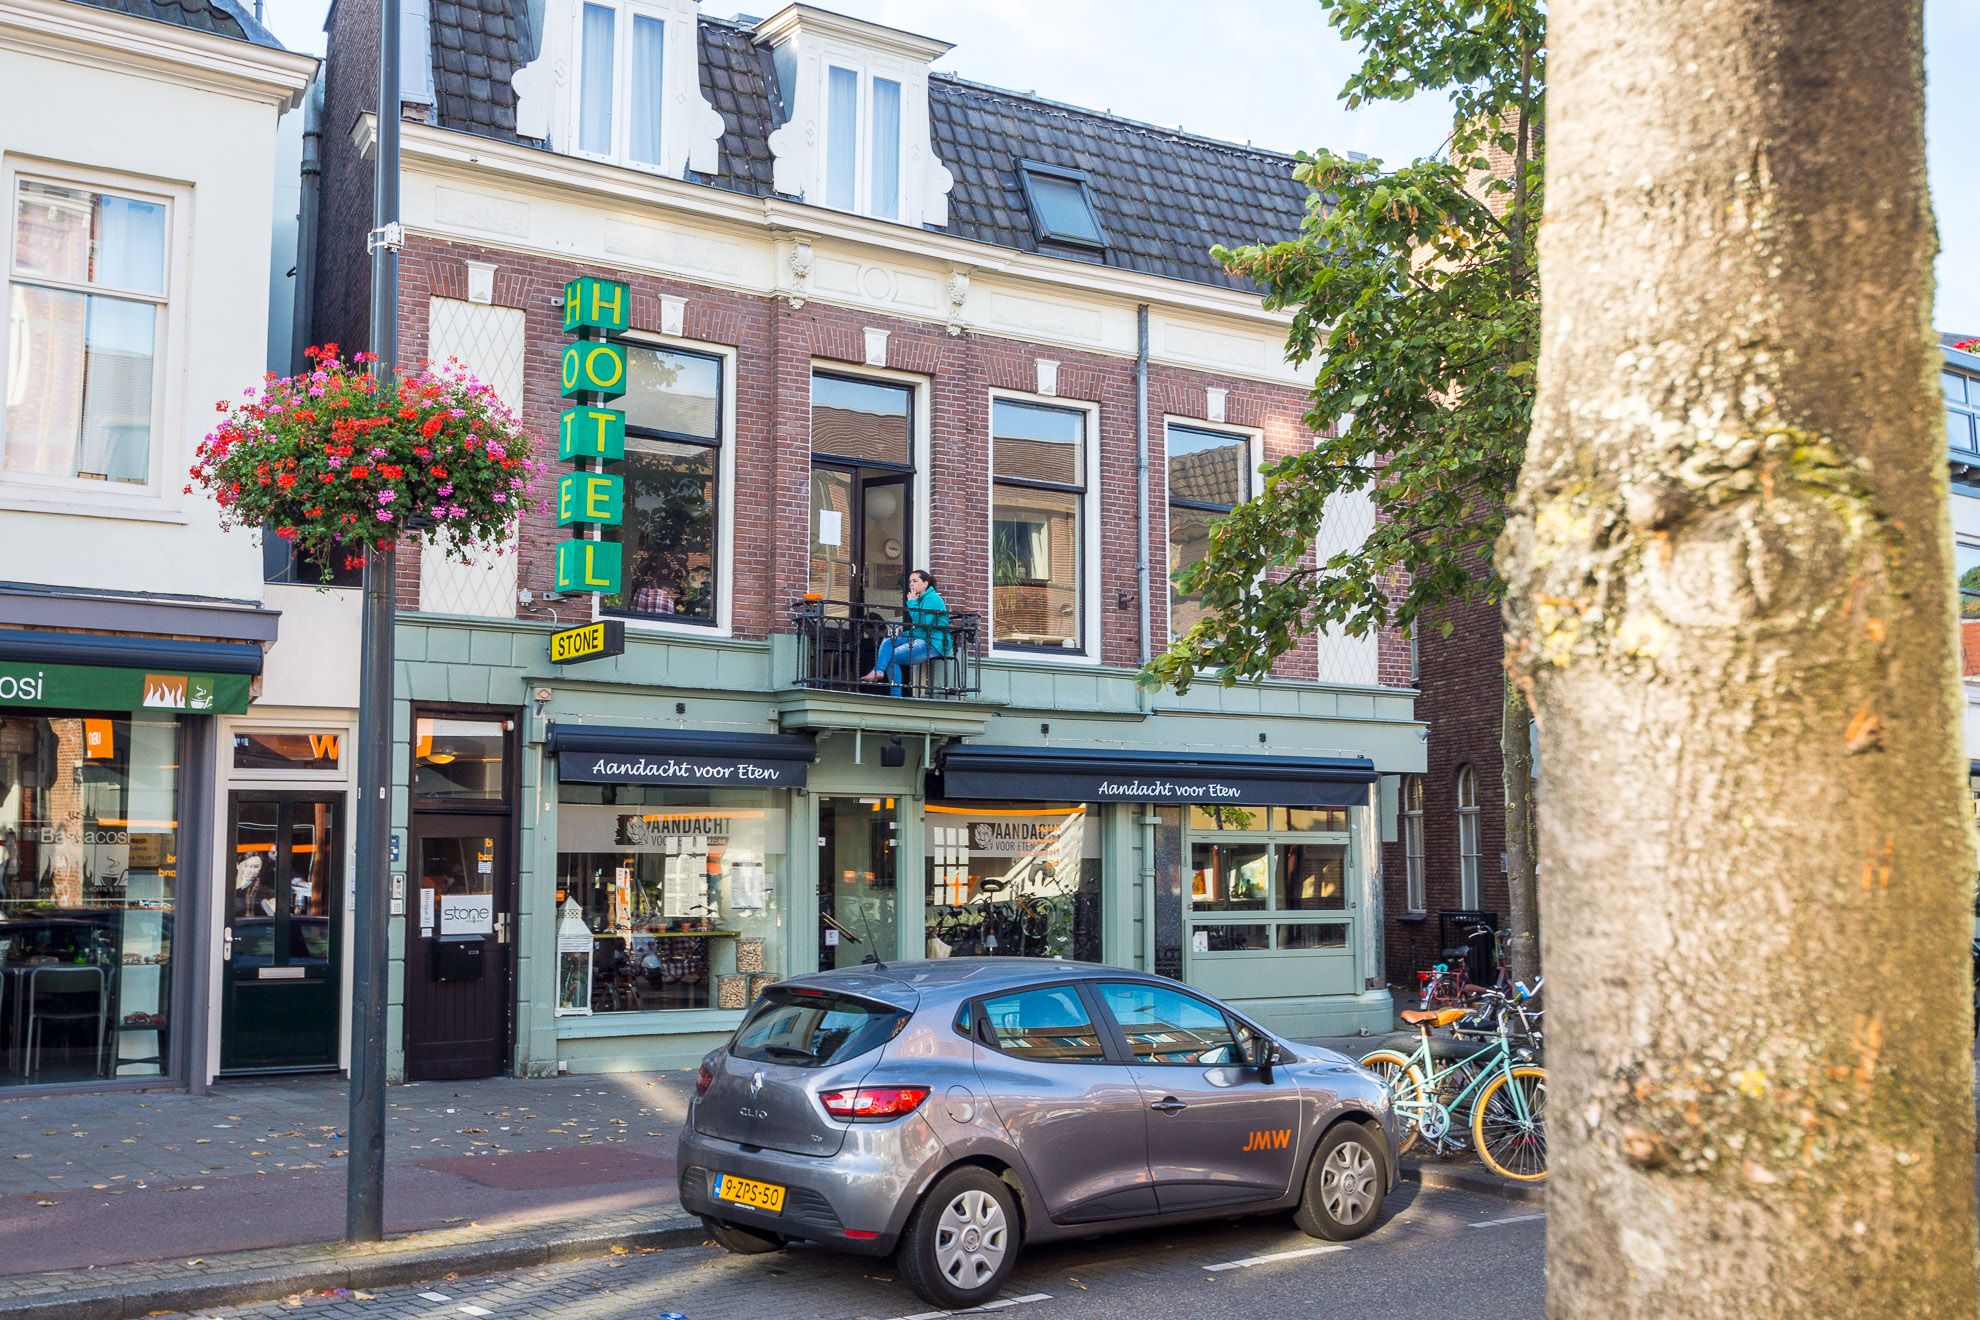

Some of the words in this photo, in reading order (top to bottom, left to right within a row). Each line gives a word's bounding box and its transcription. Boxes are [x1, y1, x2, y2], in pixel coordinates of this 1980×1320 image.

[556, 282, 582, 588] HOTEL
[585, 282, 624, 588] HOTEL
[557, 628, 600, 658] STONE
[592, 758, 691, 777] Aandacht
[693, 765, 734, 778] voor
[737, 764, 780, 780] Eten
[1098, 781, 1173, 796] Aandacht
[1175, 784, 1206, 797] voor
[1208, 783, 1241, 798] Eten
[40, 827, 131, 844] Baacosi
[651, 815, 732, 835] AANDACHT
[444, 906, 490, 921] stone
[739, 1107, 768, 1119] CLIO
[1241, 1129, 1292, 1152] JMW
[725, 1178, 779, 1206] 9-ZPS-50
